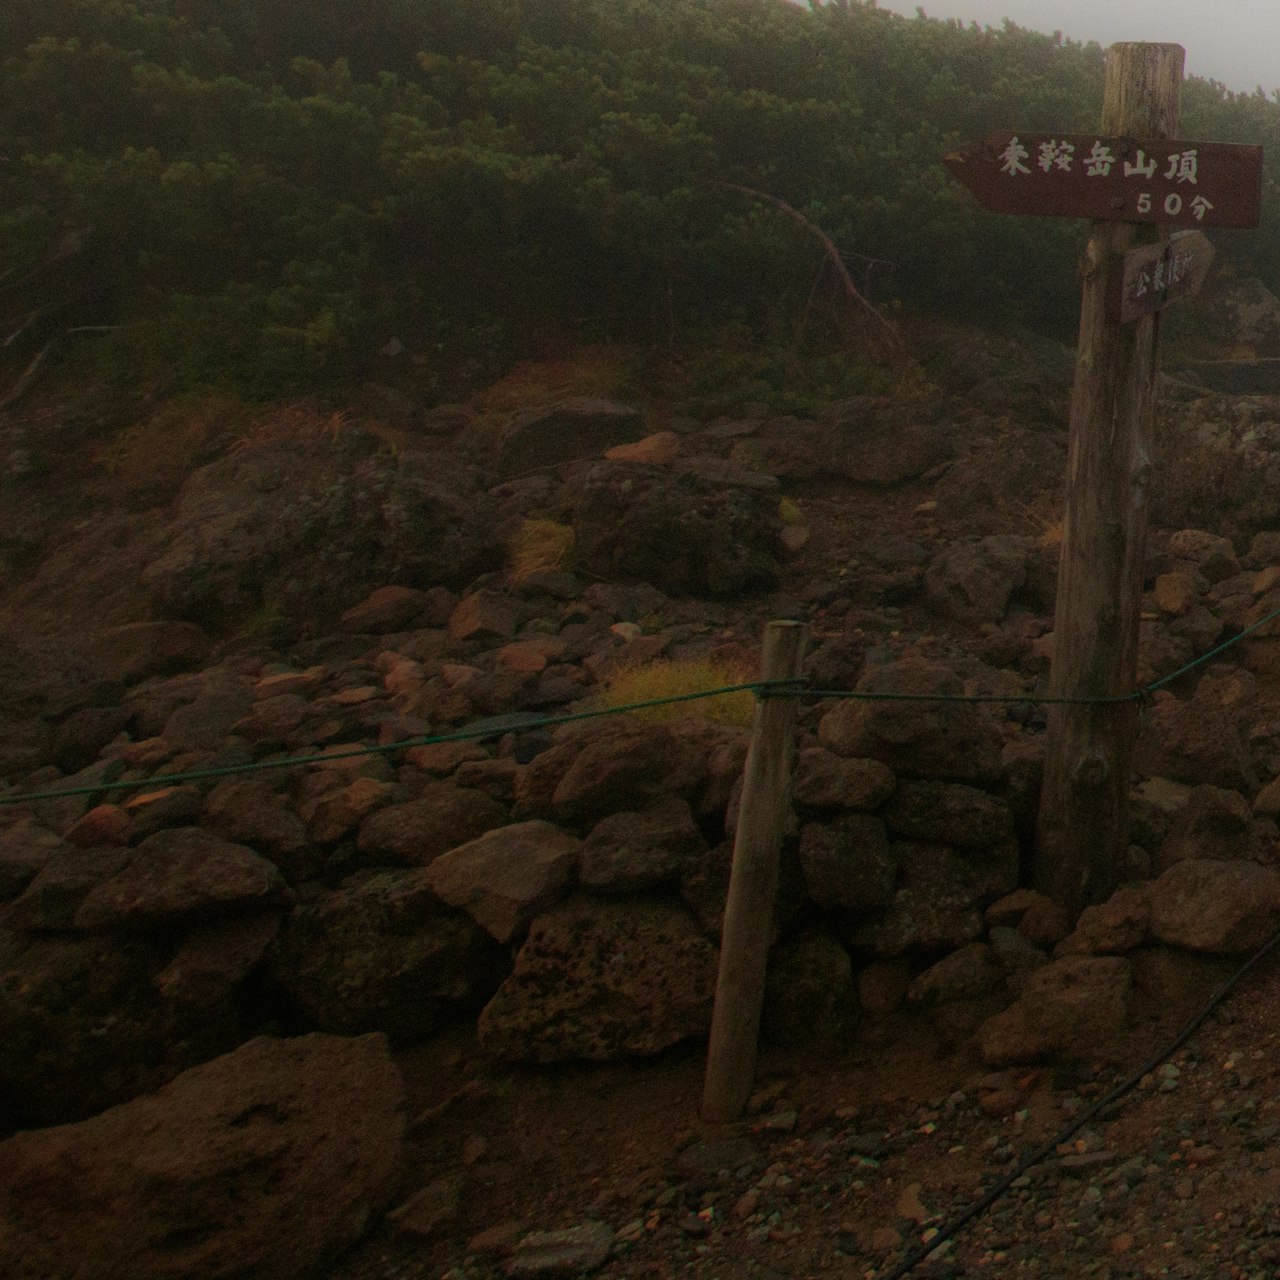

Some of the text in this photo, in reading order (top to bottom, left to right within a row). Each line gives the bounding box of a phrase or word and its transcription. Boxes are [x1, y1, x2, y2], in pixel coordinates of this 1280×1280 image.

[998, 136, 1198, 184] 乗鞍岳山頂
[1136, 193, 1214, 220] 50分
